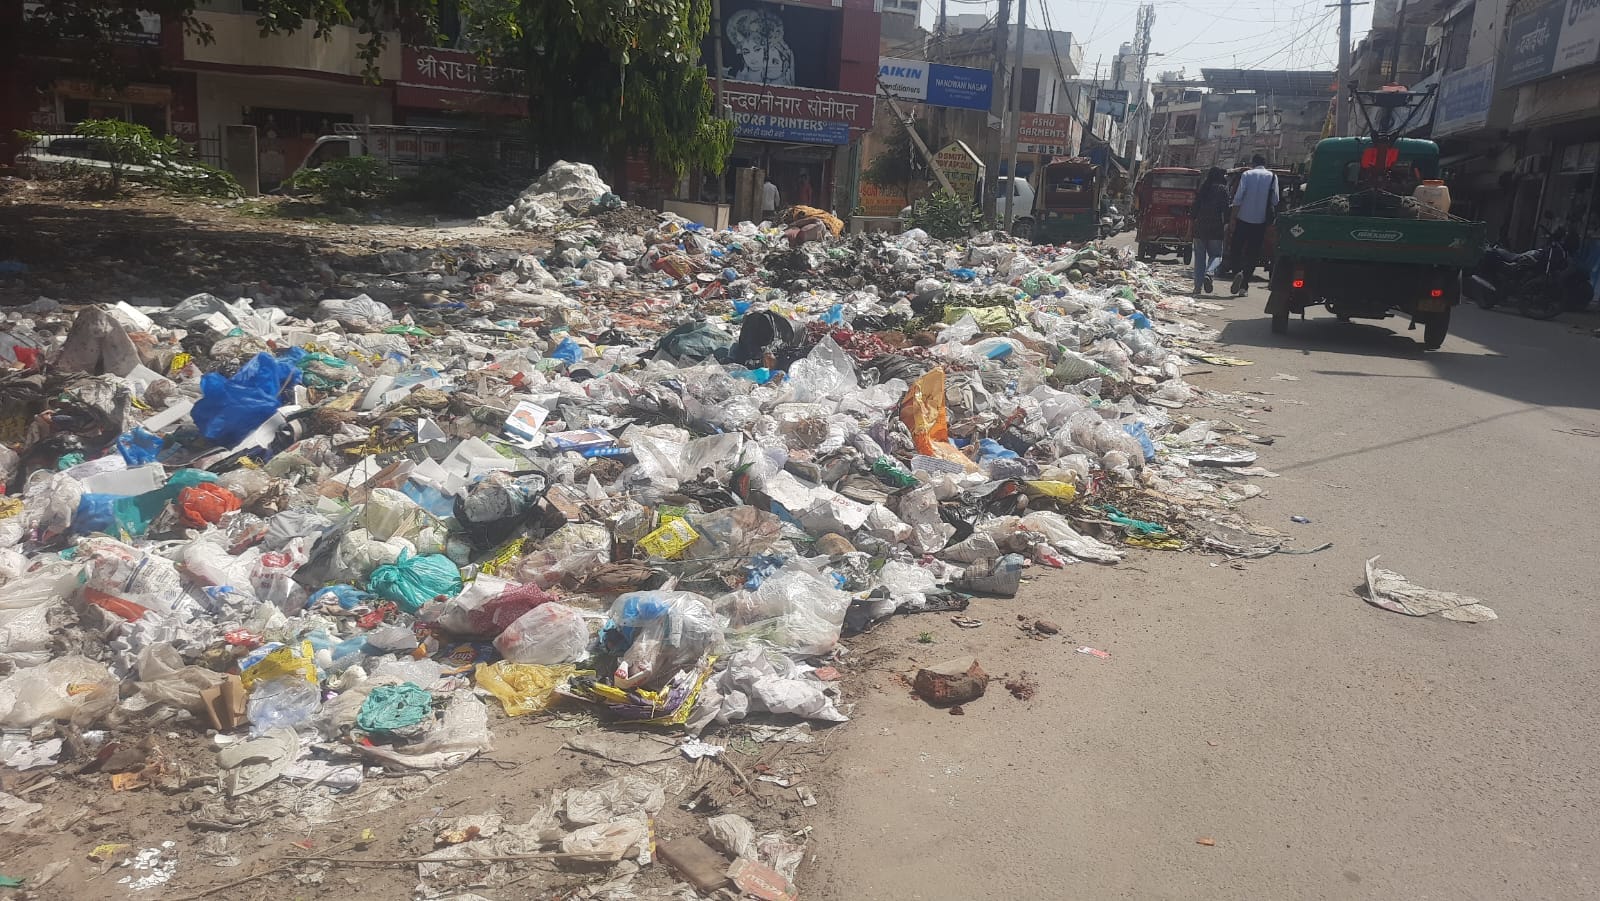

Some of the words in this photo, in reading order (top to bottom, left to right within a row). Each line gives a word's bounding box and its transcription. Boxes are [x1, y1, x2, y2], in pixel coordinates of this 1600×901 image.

[807, 95, 859, 121] सोनीपत
[769, 115, 824, 131] PRINTERS
[1032, 117, 1056, 127] ASHU
